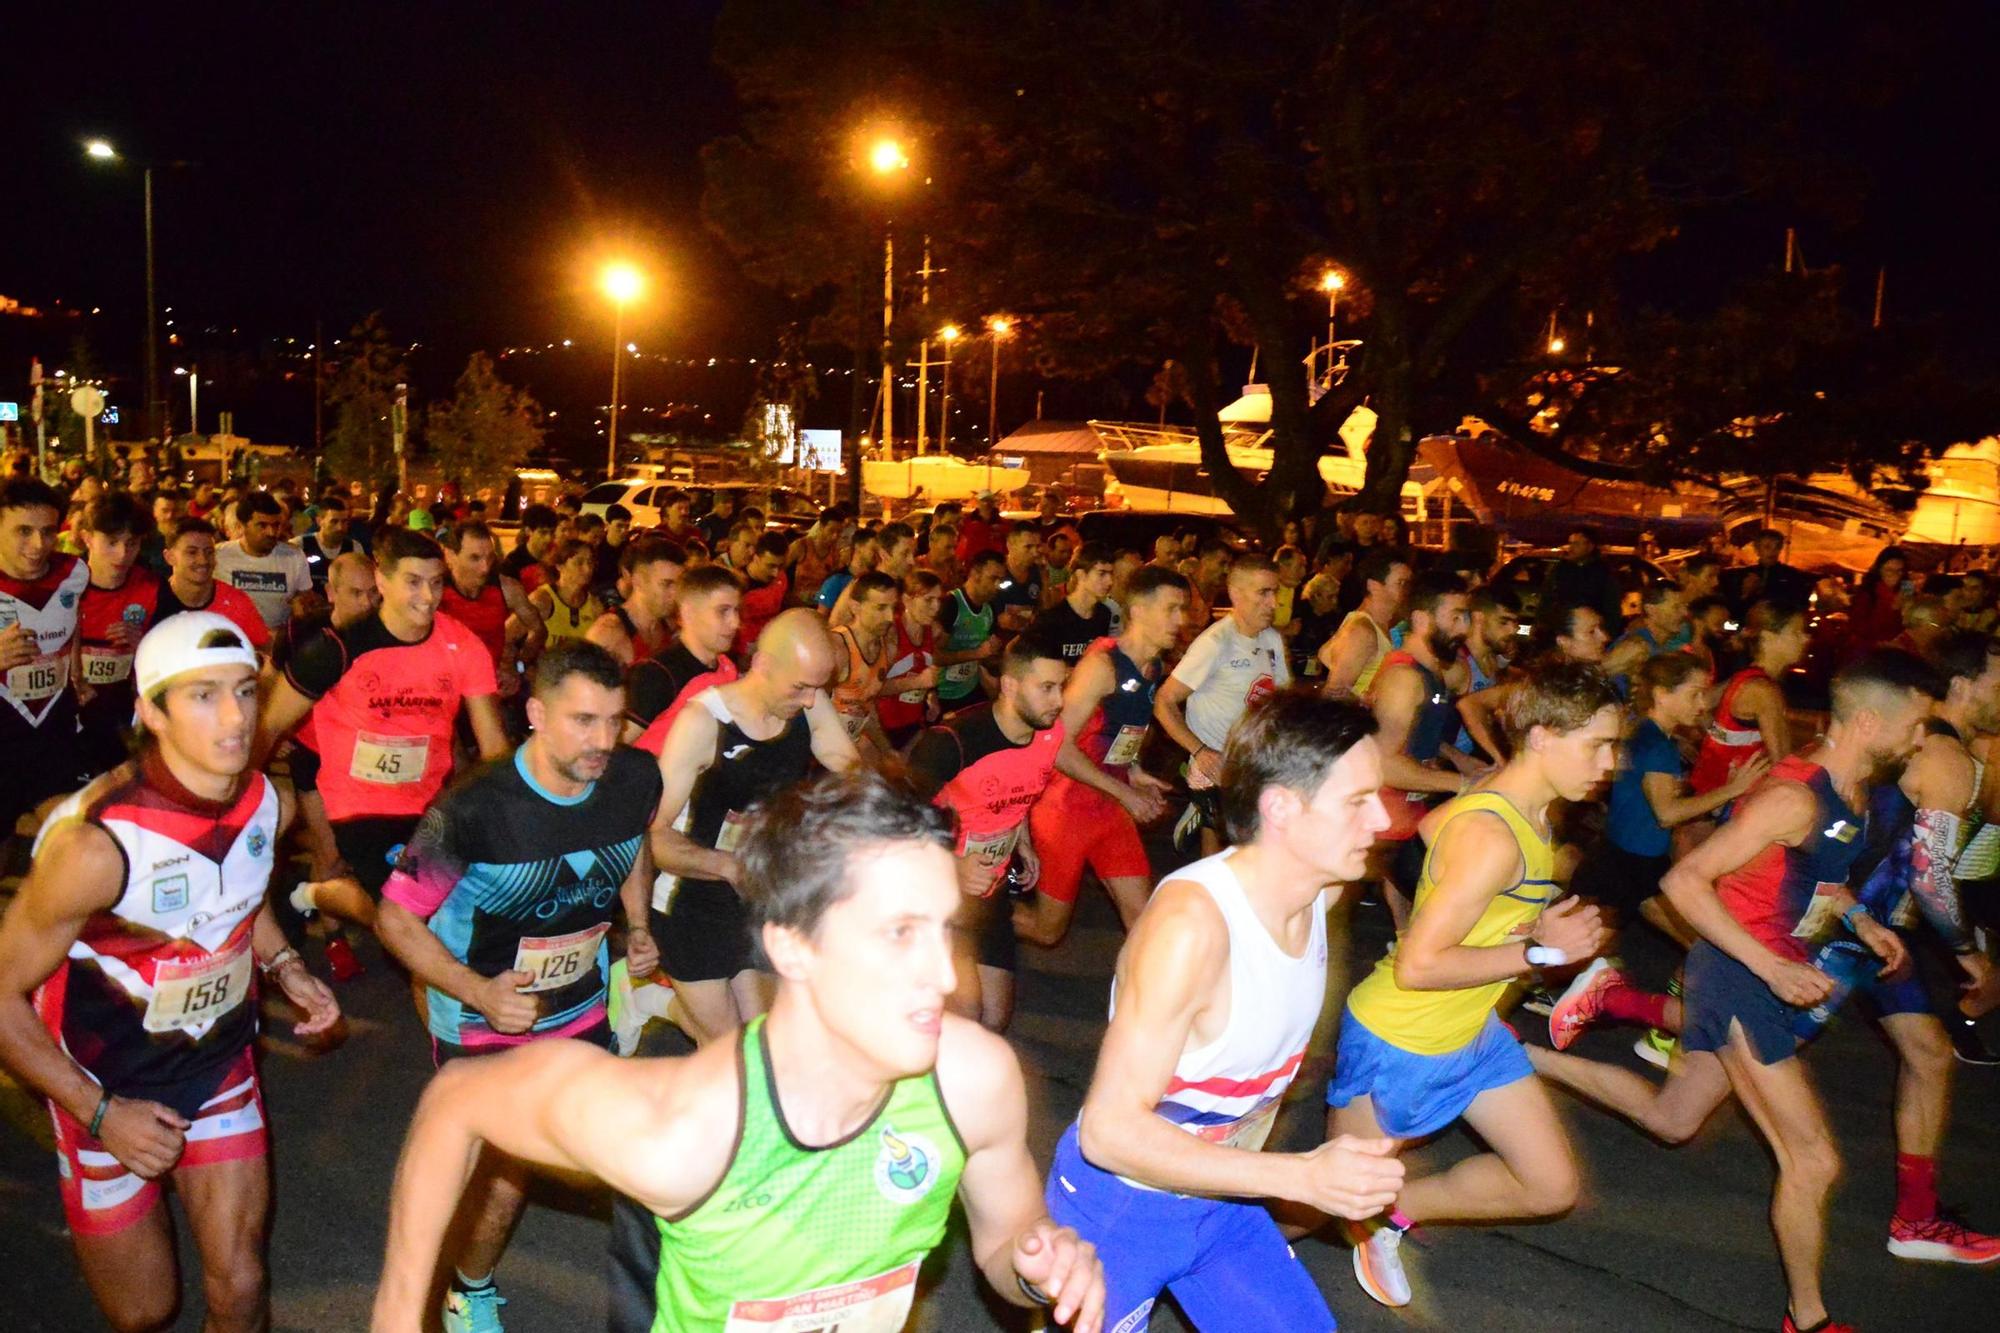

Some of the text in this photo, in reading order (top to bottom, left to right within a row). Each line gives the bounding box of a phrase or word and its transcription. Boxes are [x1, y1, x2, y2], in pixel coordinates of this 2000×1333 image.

[29, 667, 56, 690] 105
[89, 661, 115, 677] 139
[375, 753, 402, 774] 45
[540, 951, 580, 980] 126
[182, 974, 231, 1014] 158
